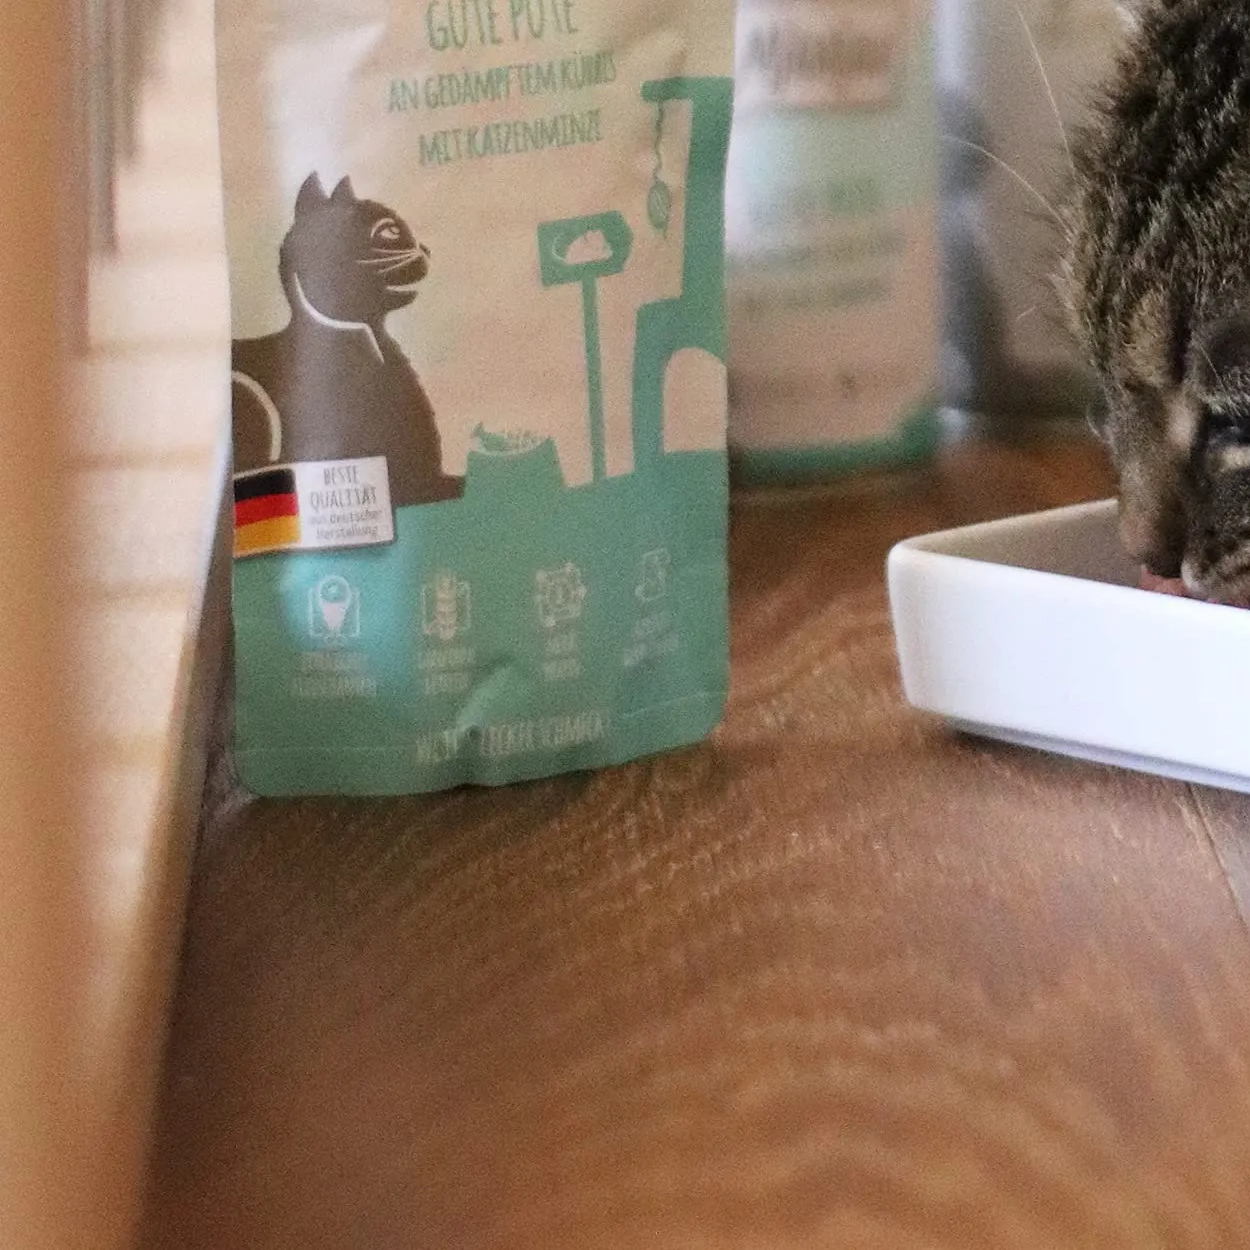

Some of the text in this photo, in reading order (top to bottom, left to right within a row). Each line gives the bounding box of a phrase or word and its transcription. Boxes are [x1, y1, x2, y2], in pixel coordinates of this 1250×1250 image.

[388, 77, 419, 112] AN
[418, 109, 604, 167] MIT KATZENMINZE
[323, 465, 360, 486] BESTE
